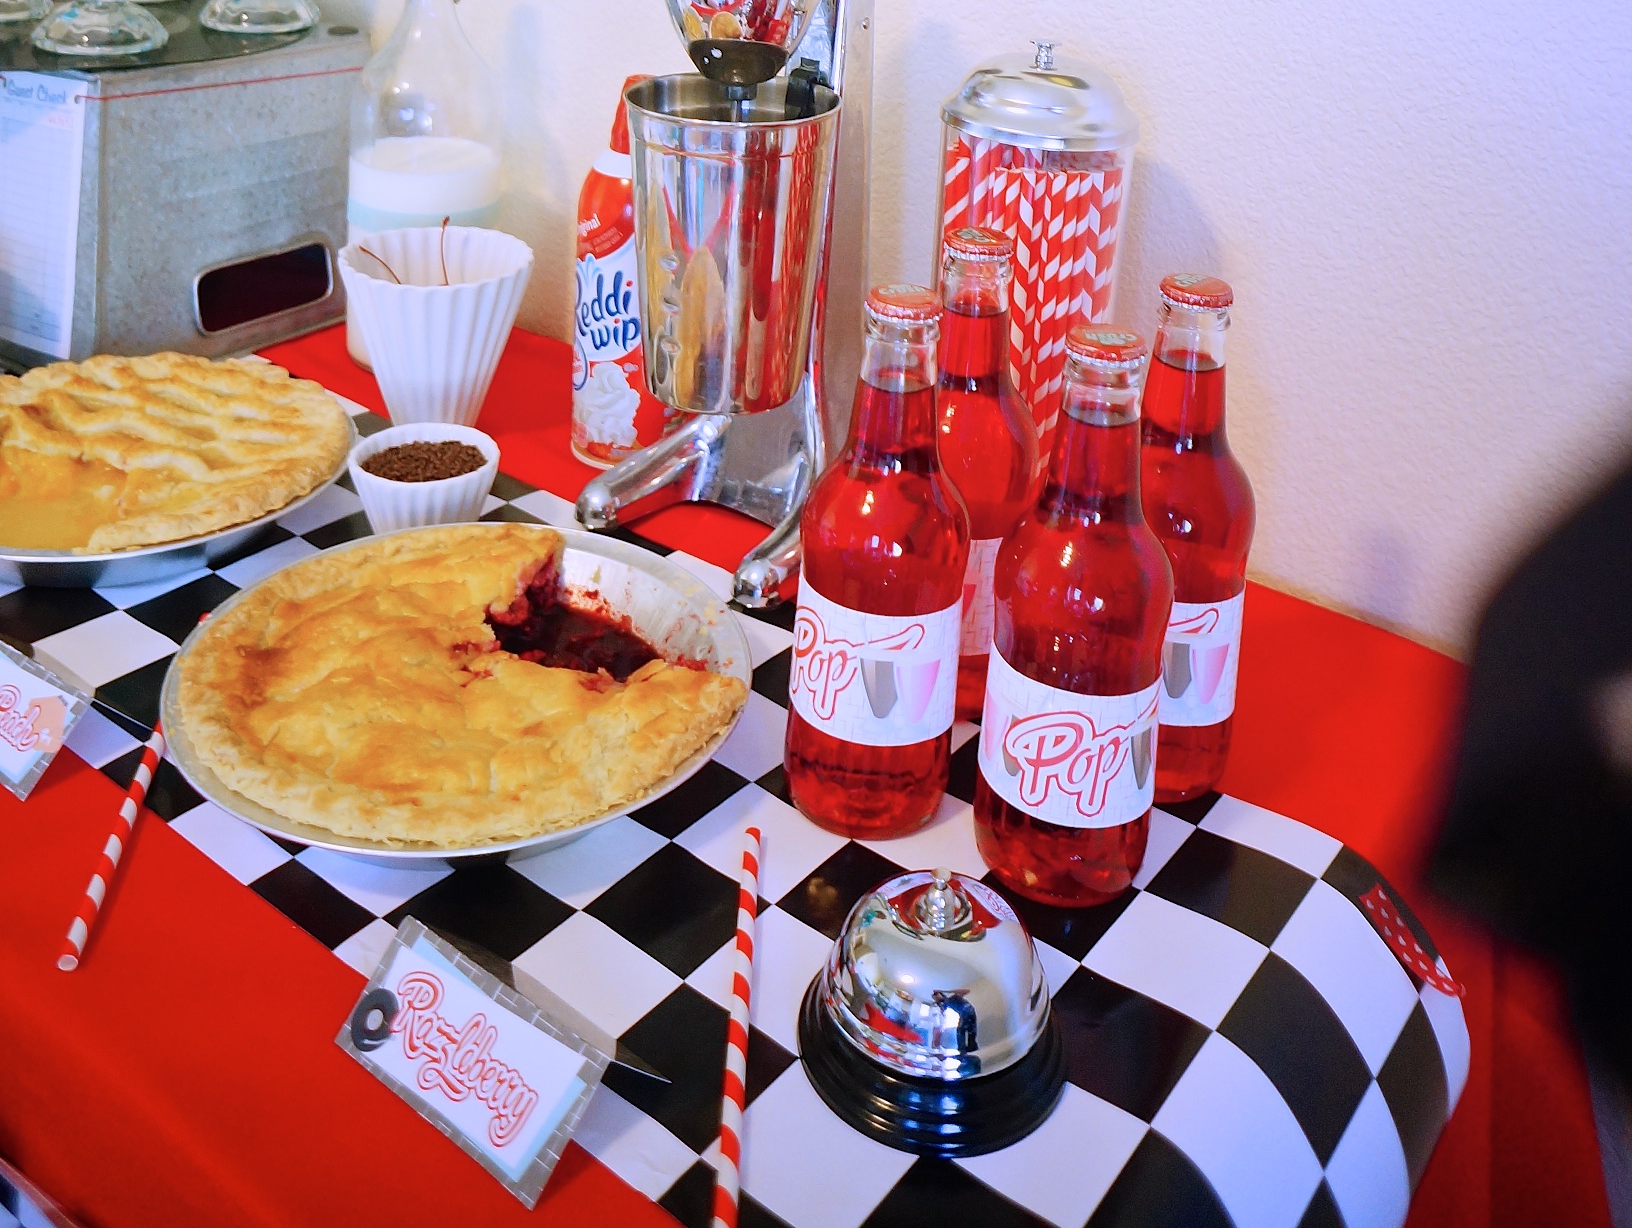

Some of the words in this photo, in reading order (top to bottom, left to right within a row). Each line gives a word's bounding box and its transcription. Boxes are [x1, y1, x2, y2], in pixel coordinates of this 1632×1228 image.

[590, 317, 642, 352] wip
[791, 605, 860, 721] Pop
[1004, 710, 1130, 817] Pop
